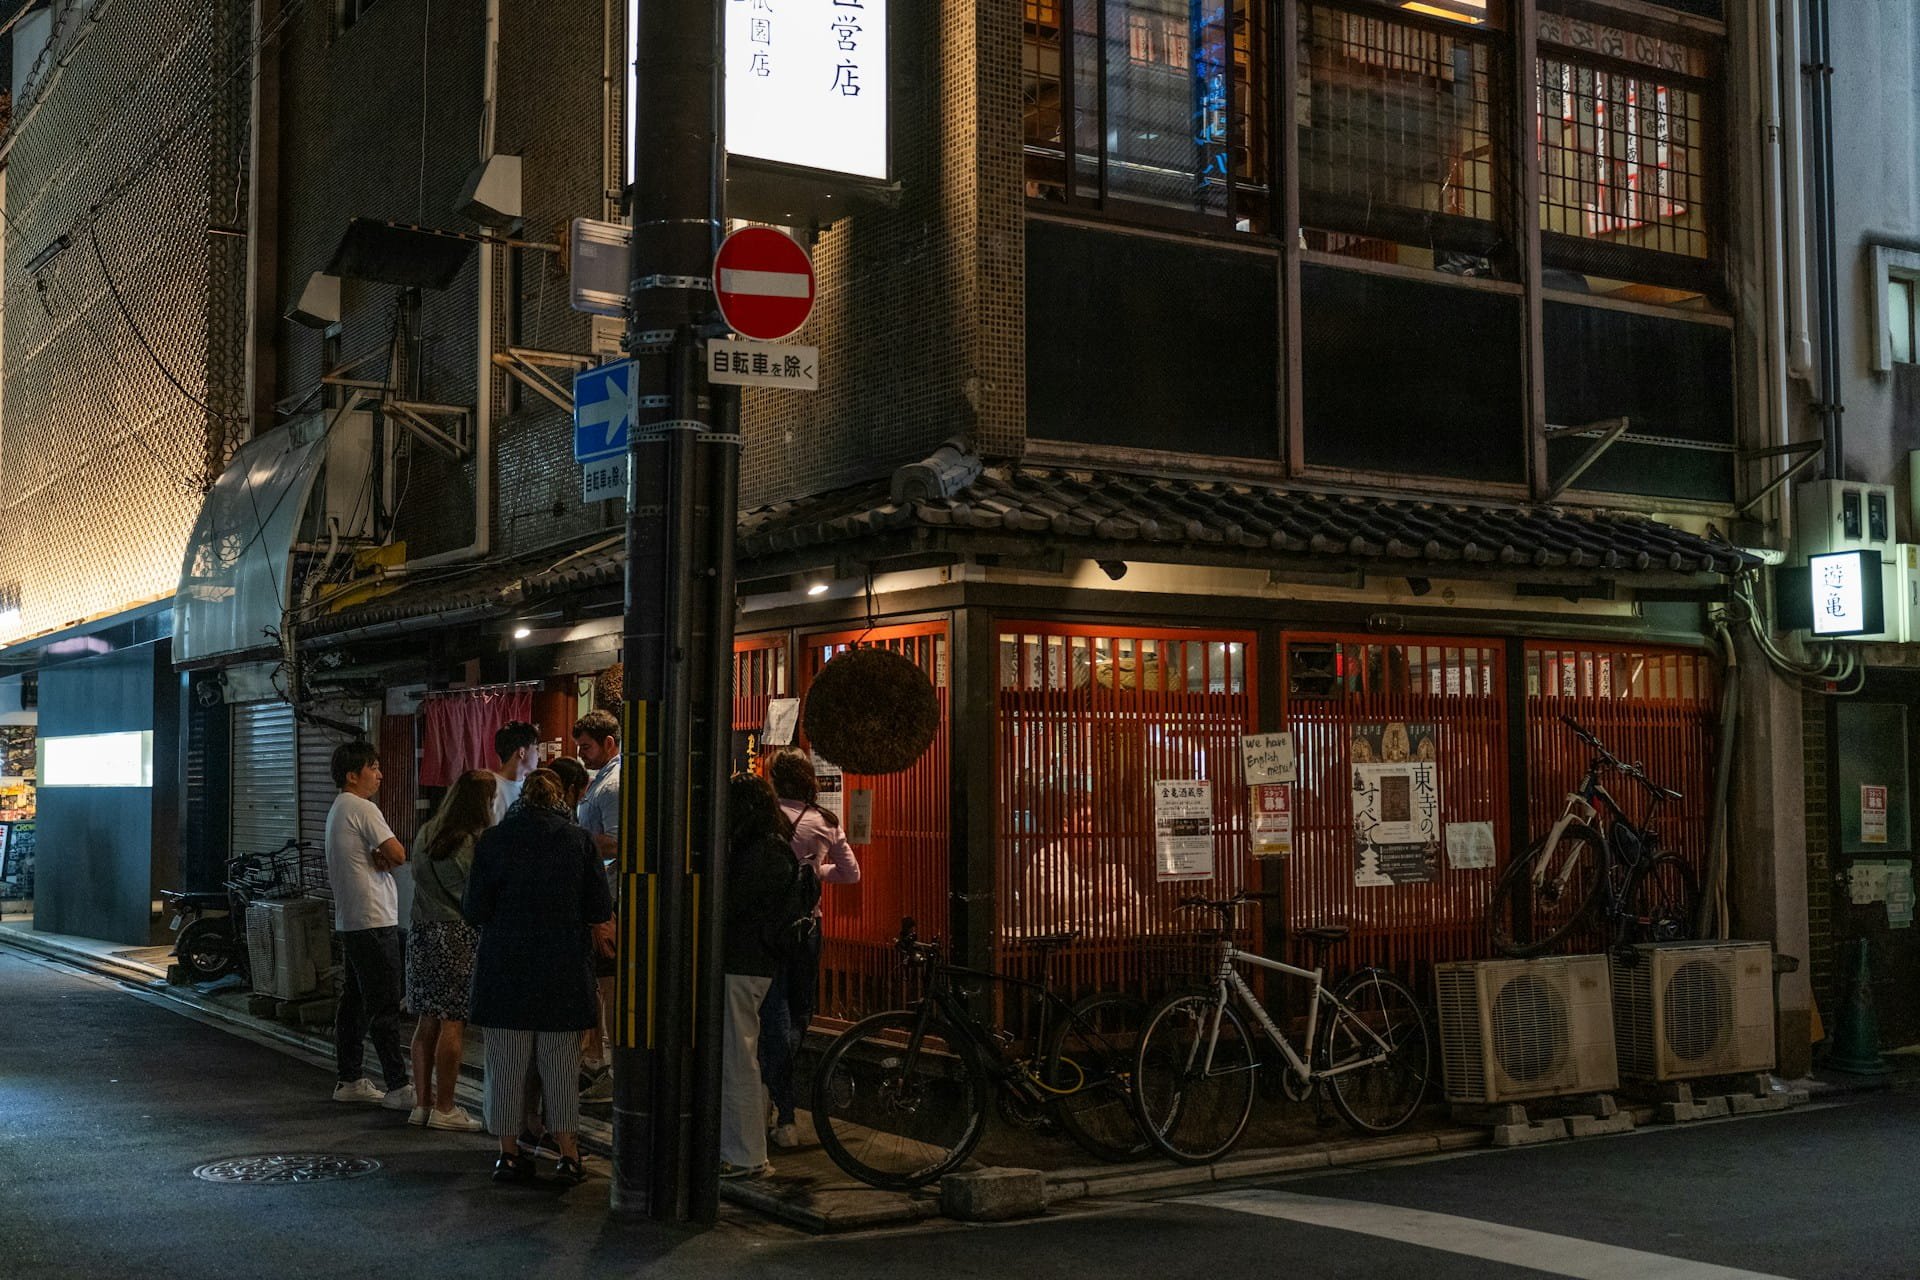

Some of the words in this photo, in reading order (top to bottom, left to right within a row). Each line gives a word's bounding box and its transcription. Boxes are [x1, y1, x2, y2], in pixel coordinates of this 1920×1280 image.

[713, 349, 813, 380] 自転車を除く
[1246, 739, 1262, 748] We
[1266, 737, 1287, 748] have
[1247, 750, 1278, 768] English
[1358, 782, 1380, 844] すべて
[1412, 762, 1437, 834] 東寺の
